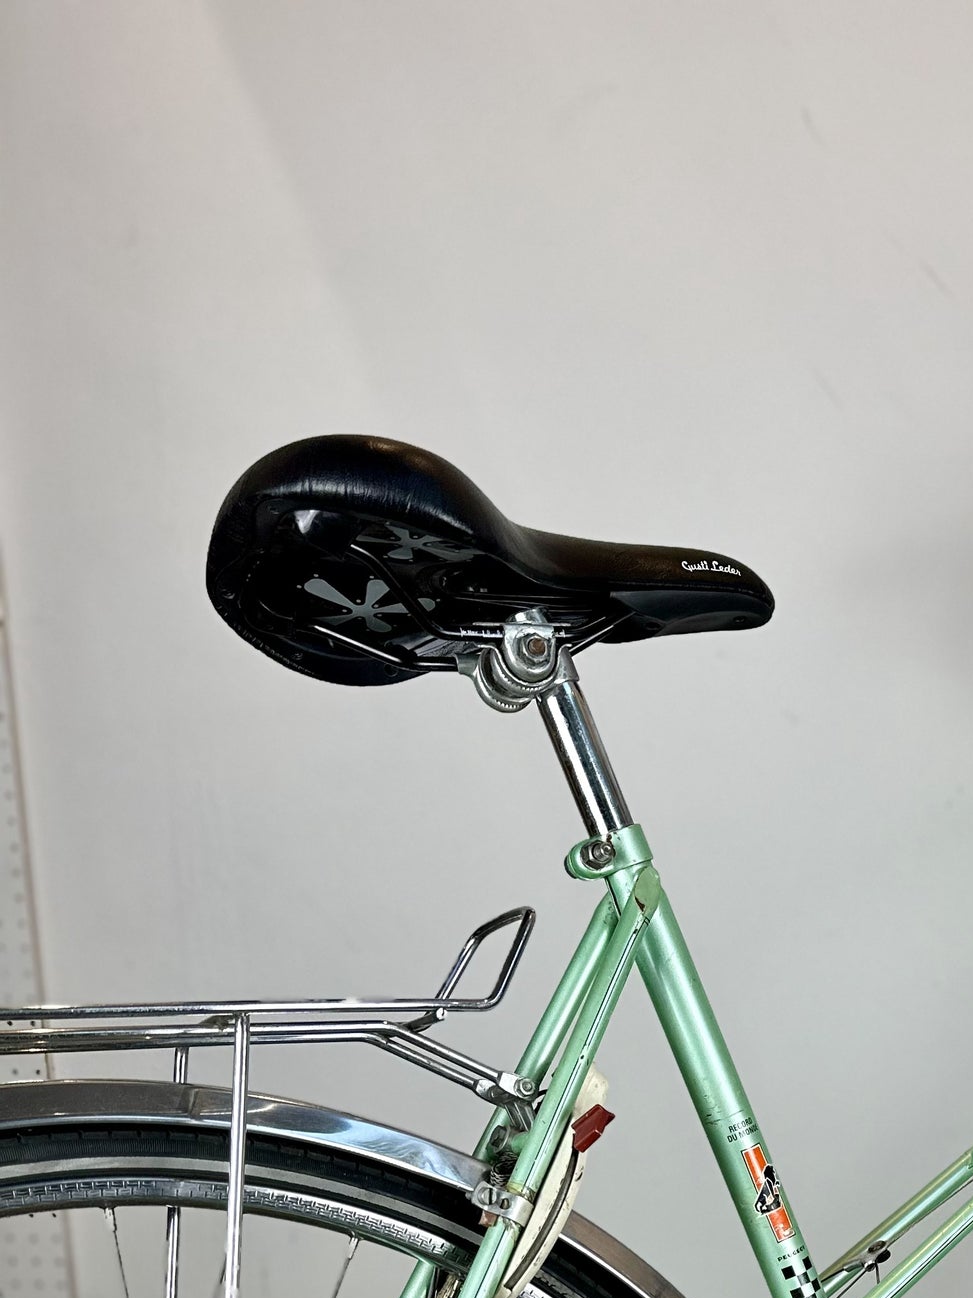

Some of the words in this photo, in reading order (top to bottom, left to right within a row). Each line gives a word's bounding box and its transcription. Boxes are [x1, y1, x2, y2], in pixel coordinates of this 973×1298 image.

[681, 561, 709, 572] Gusti
[710, 560, 741, 576] Leder
[728, 1117, 753, 1133] RECORD
[727, 1133, 738, 1143] DU
